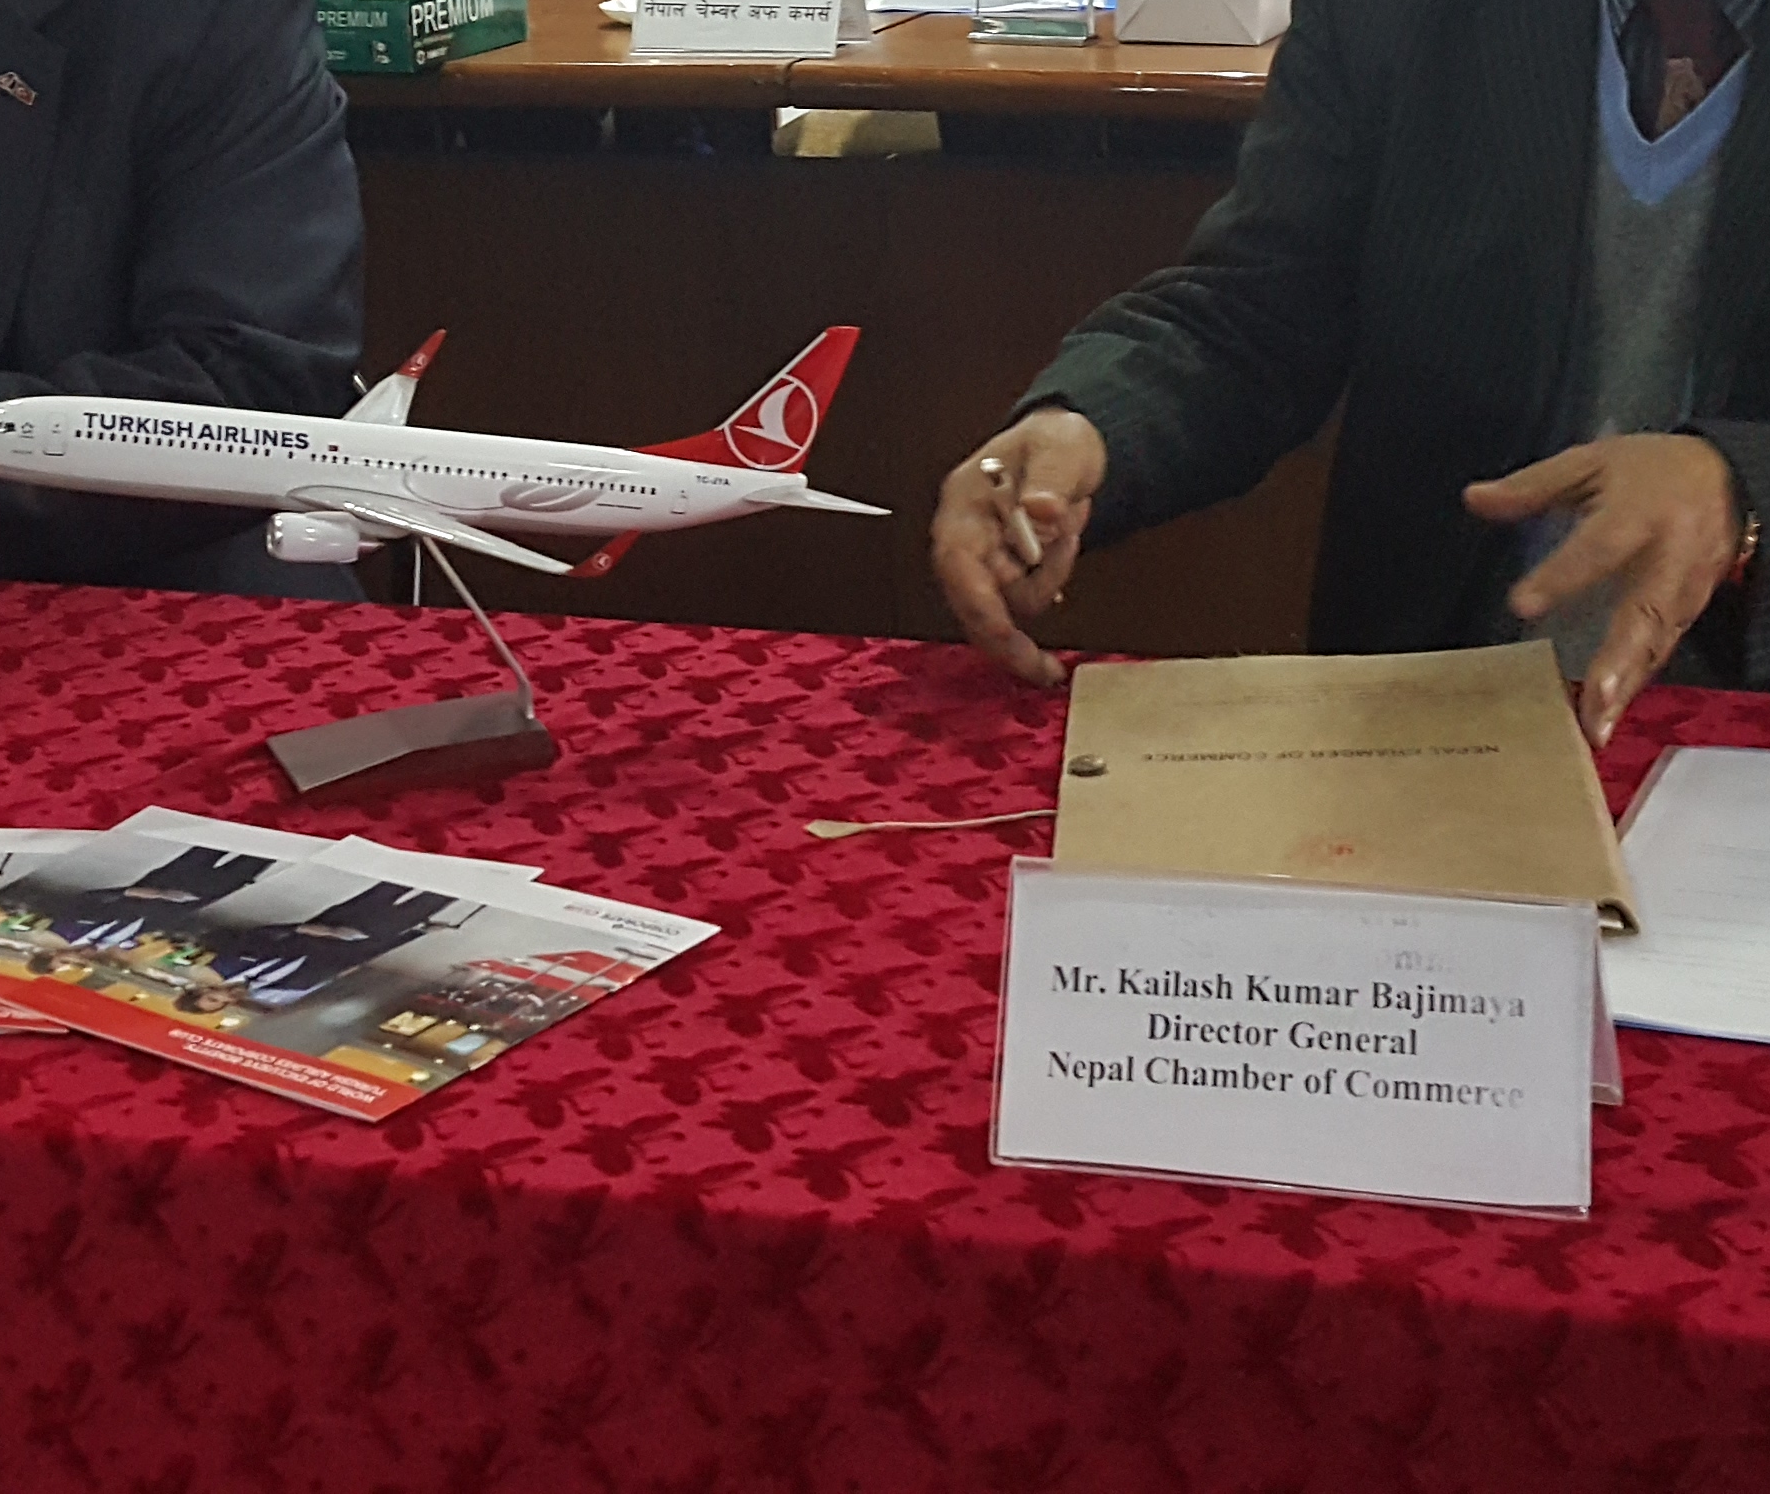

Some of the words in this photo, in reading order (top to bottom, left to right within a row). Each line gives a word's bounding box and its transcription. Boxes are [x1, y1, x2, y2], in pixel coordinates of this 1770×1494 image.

[316, 10, 389, 28] PREMIUM
[788, 0, 833, 23] कमर्स
[82, 412, 193, 439] TURKISH
[197, 423, 311, 450] AIRLINES
[1140, 750, 1268, 764] COMMERCE
[1051, 965, 1107, 996] Mr.
[1117, 967, 1234, 1003] Kailash
[1246, 974, 1360, 1011] Kumar
[1372, 981, 1526, 1024] Bajimaya
[1147, 1013, 1279, 1049] Director
[1289, 1021, 1419, 1057] General
[1046, 1050, 1134, 1089] Nepal
[1145, 1057, 1294, 1094] Chamber
[1304, 1067, 1339, 1097] of
[1345, 1070, 1526, 1109] Commerce
